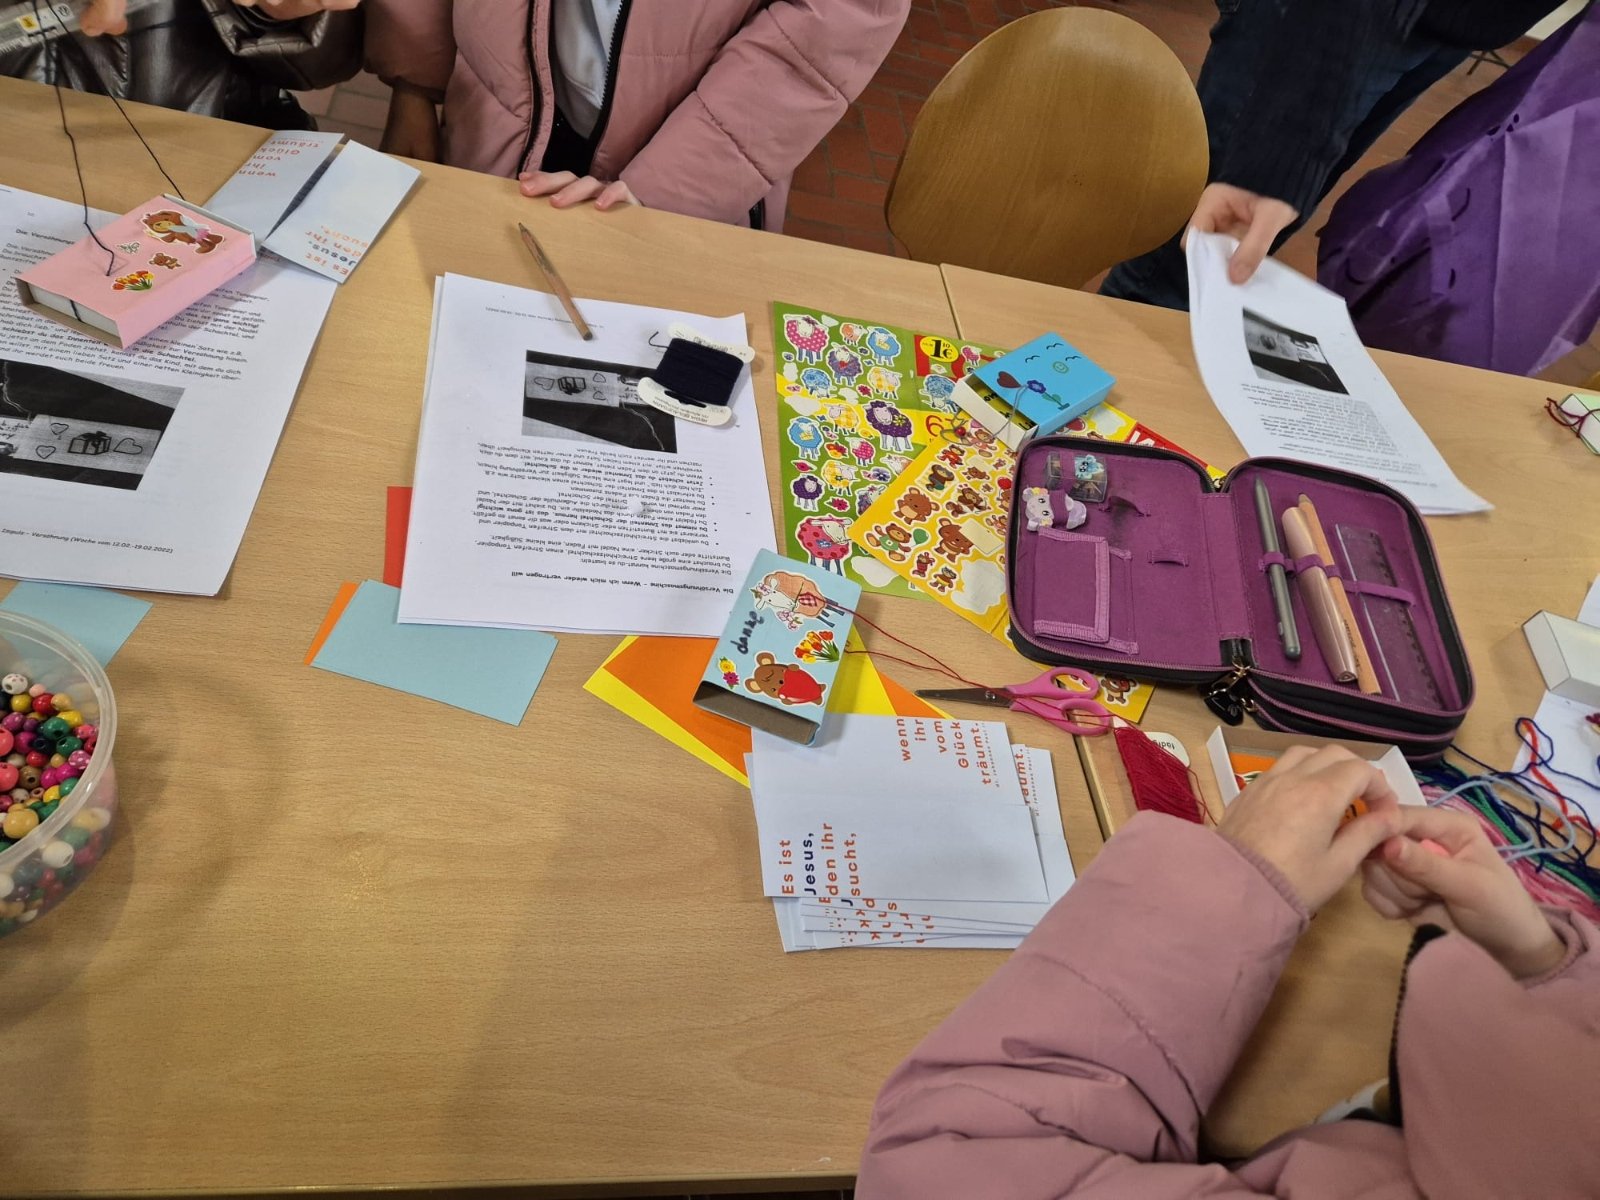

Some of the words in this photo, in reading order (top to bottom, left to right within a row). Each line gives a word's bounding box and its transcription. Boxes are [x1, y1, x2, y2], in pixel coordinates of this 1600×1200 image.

[332, 264, 350, 275] Es
[525, 571, 561, 579] vertragen
[649, 581, 720, 592] Versöhnungsmaschine
[896, 718, 912, 761] wenn
[914, 718, 926, 742] ihr
[934, 720, 948, 754] vom
[950, 722, 970, 768] Glück
[970, 722, 992, 784] träumt.
[821, 823, 834, 850] ihr
[779, 840, 792, 864] ist
[804, 832, 816, 895] Jesus,
[844, 833, 860, 896] sucht,
[782, 874, 794, 894] Es
[826, 858, 838, 896] den
